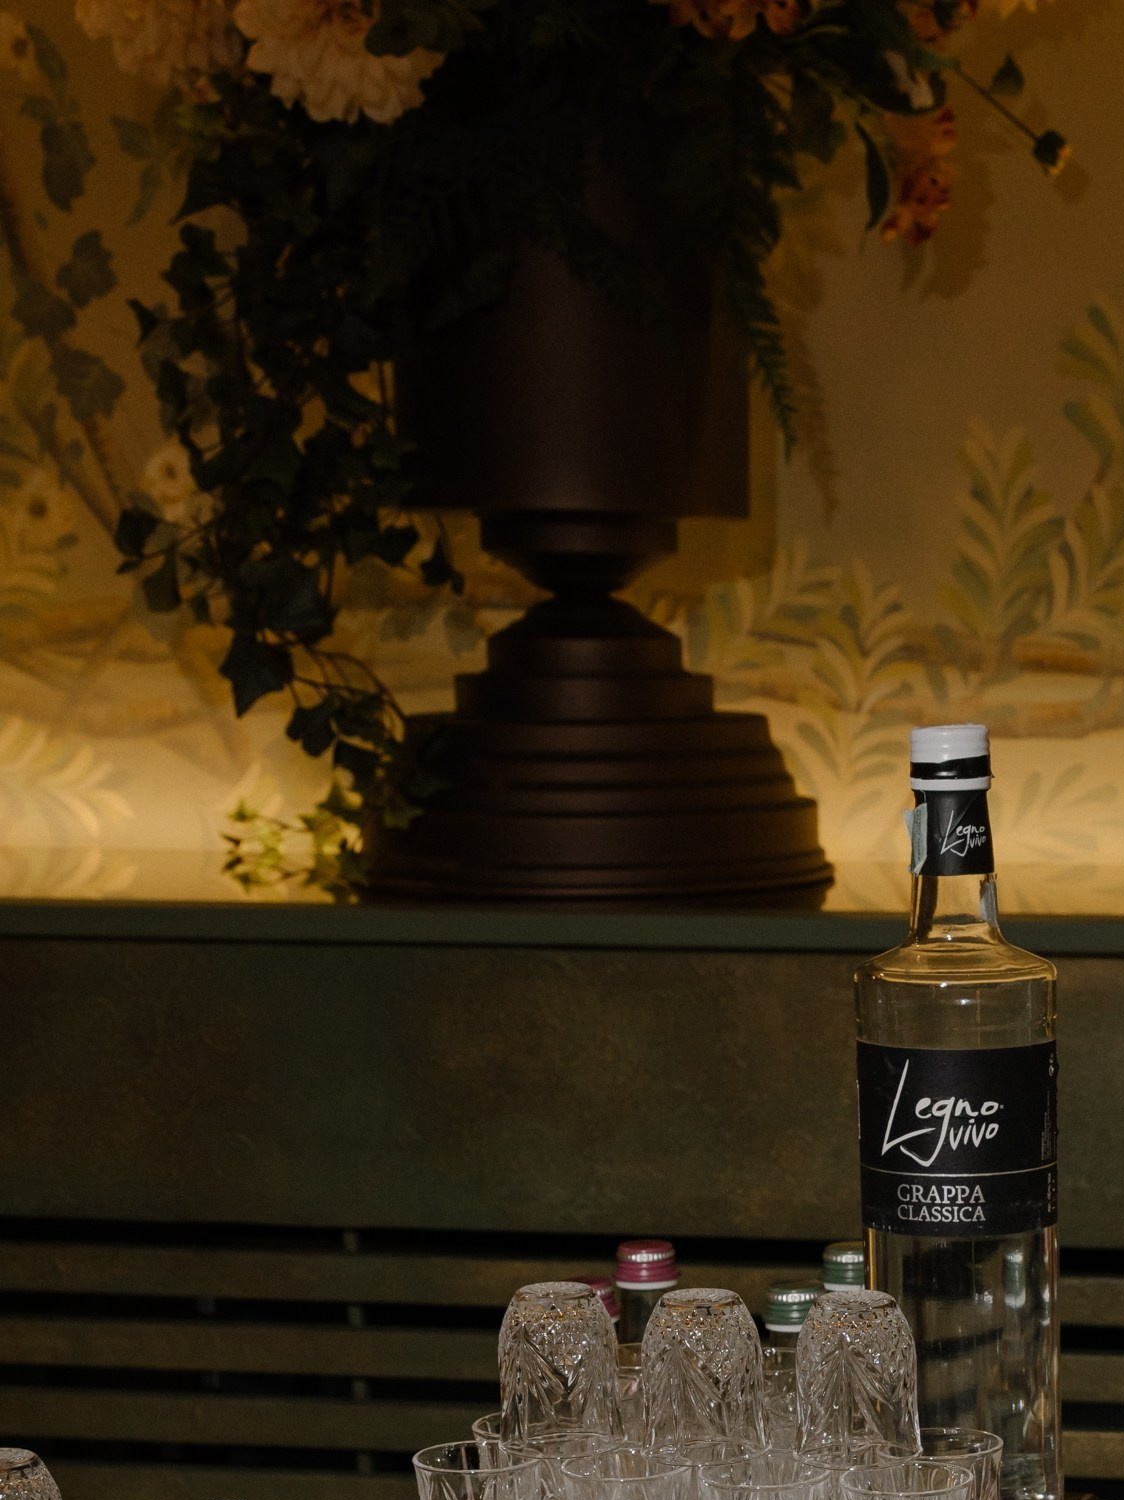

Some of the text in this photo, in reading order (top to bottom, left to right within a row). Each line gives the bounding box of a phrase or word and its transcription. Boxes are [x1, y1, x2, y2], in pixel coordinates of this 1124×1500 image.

[940, 810, 985, 857] Legno
[969, 834, 987, 849] vivo
[881, 1058, 1000, 1167] Legno
[949, 1118, 1000, 1151] vivo
[897, 1183, 986, 1204] GRAPPA
[897, 1204, 986, 1223] CLASSICA
